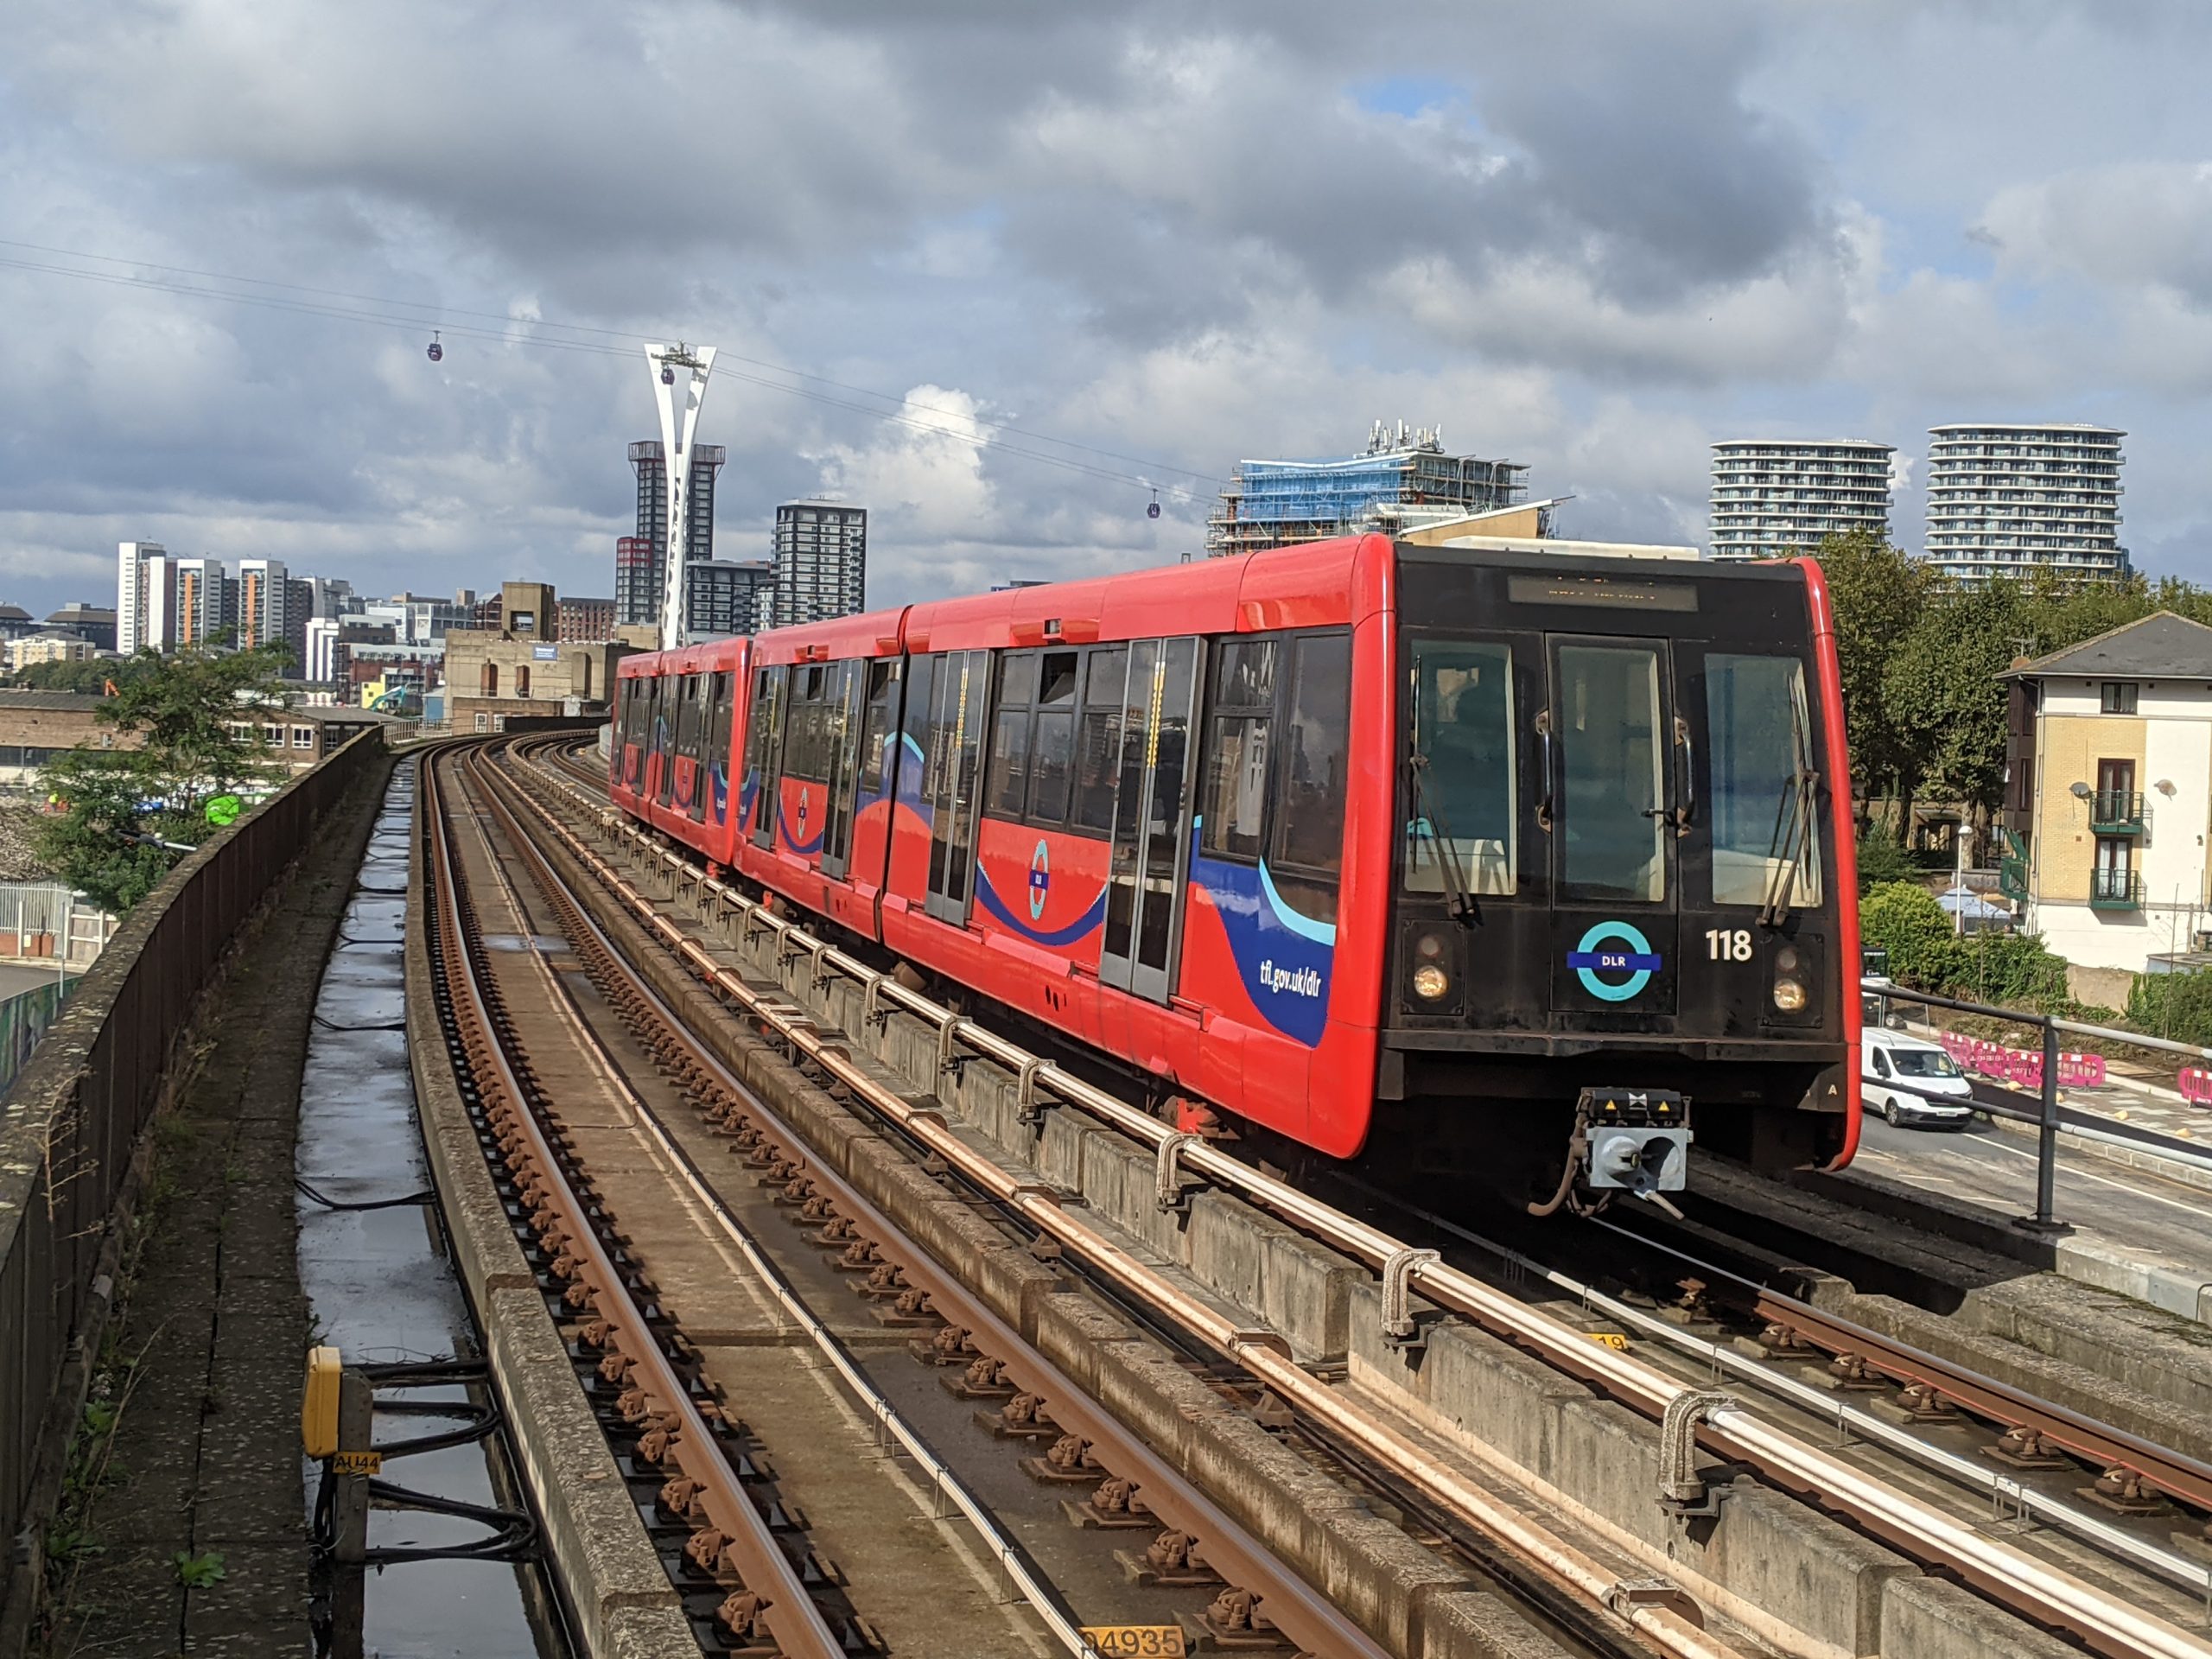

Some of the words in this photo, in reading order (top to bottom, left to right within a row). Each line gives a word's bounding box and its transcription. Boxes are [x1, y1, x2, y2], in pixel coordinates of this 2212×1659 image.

[1706, 929, 1752, 962] 118
[1602, 956, 1625, 967] DLR
[1260, 959, 1322, 997] tfl.gov.uk/dlr
[1827, 1084, 1838, 1096] A
